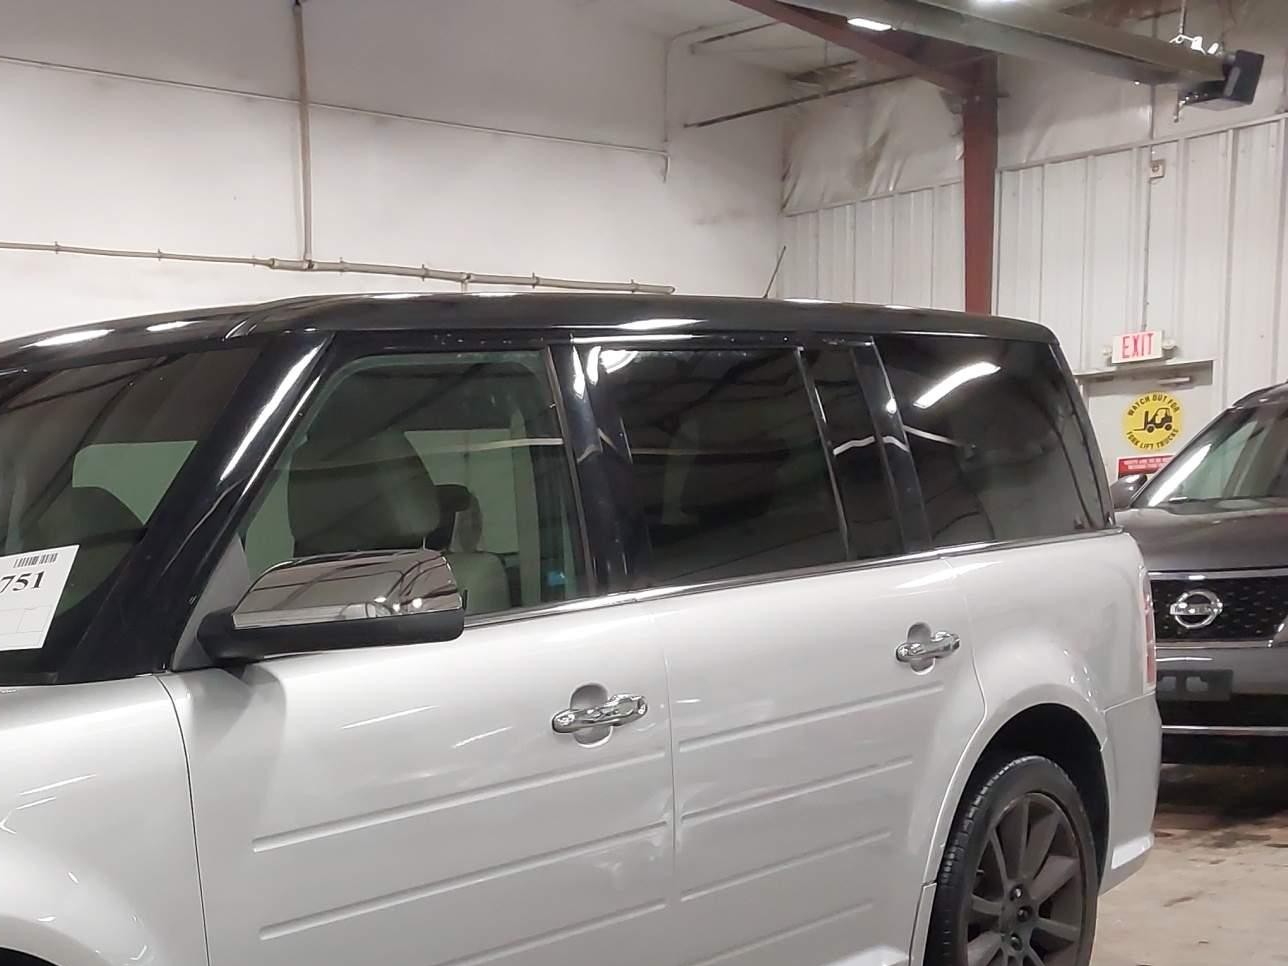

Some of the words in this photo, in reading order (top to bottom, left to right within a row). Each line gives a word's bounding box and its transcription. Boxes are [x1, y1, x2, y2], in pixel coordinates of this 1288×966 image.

[1121, 332, 1155, 359] EXIT
[1127, 395, 1151, 417] WATCH
[1152, 393, 1167, 402] OUT
[1167, 397, 1181, 414] FOR
[1126, 430, 1139, 447] FORK
[1139, 442, 1155, 450] LIFT
[1156, 428, 1180, 449] TRUCKS
